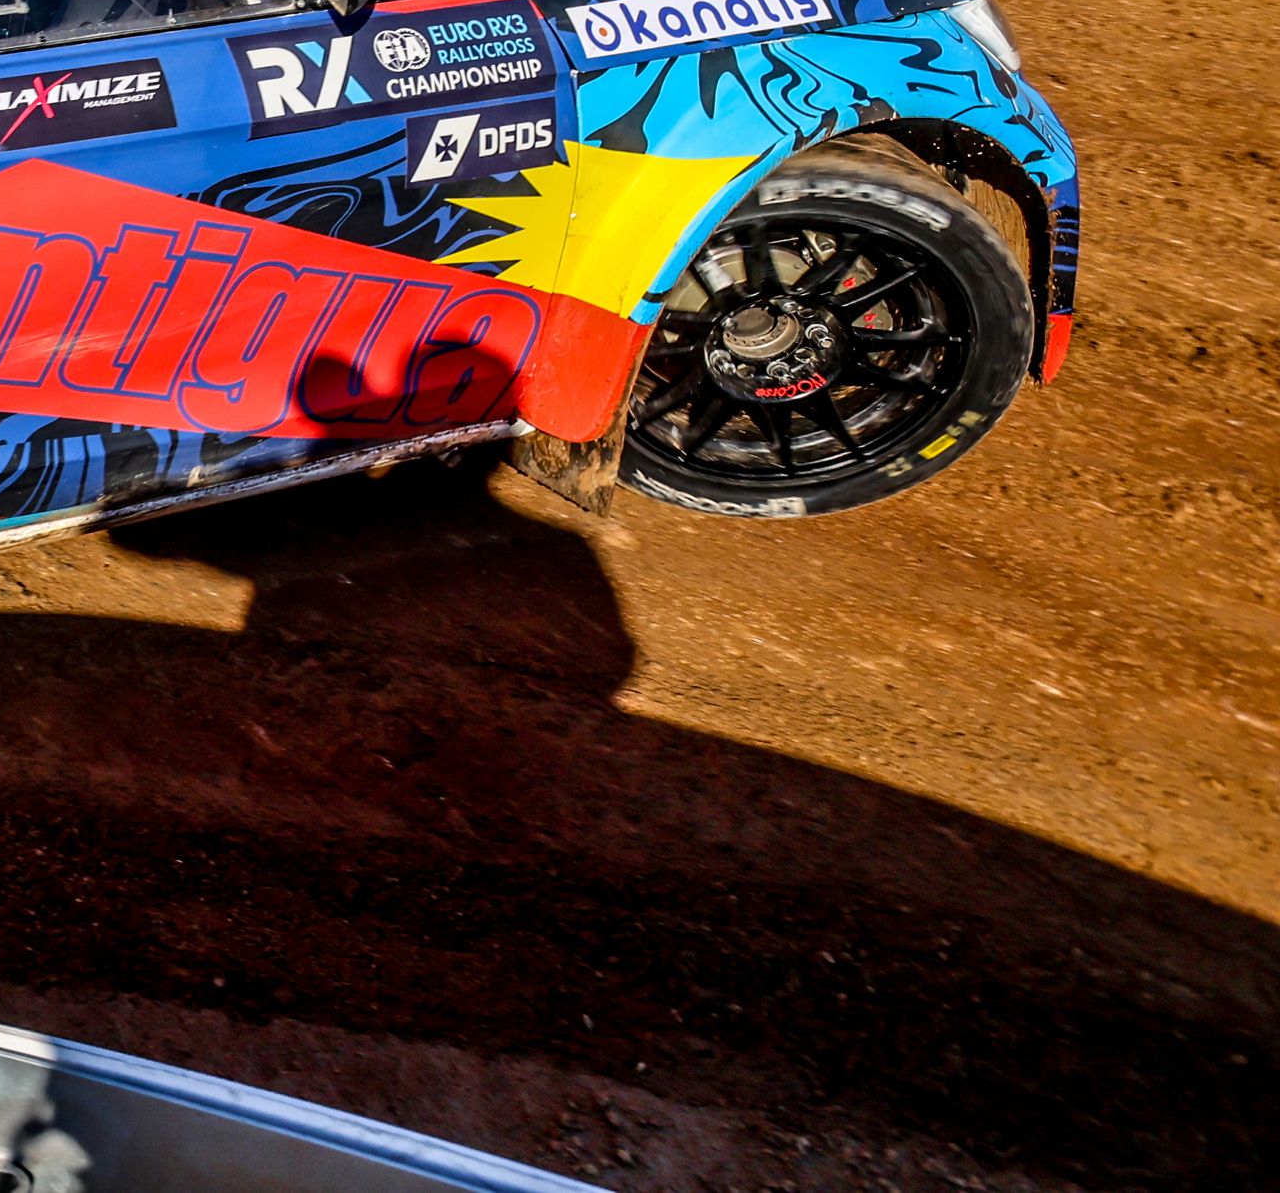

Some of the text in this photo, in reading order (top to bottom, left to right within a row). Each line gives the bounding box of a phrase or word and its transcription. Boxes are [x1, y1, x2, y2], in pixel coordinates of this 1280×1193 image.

[427, 14, 528, 46] EURO RX3
[437, 36, 535, 66] RALLYCROSS
[246, 35, 373, 118] RX
[386, 59, 542, 100] CHAMPIONSHIP
[82, 92, 156, 110] MANAGEMENT
[477, 118, 553, 158] DFDS
